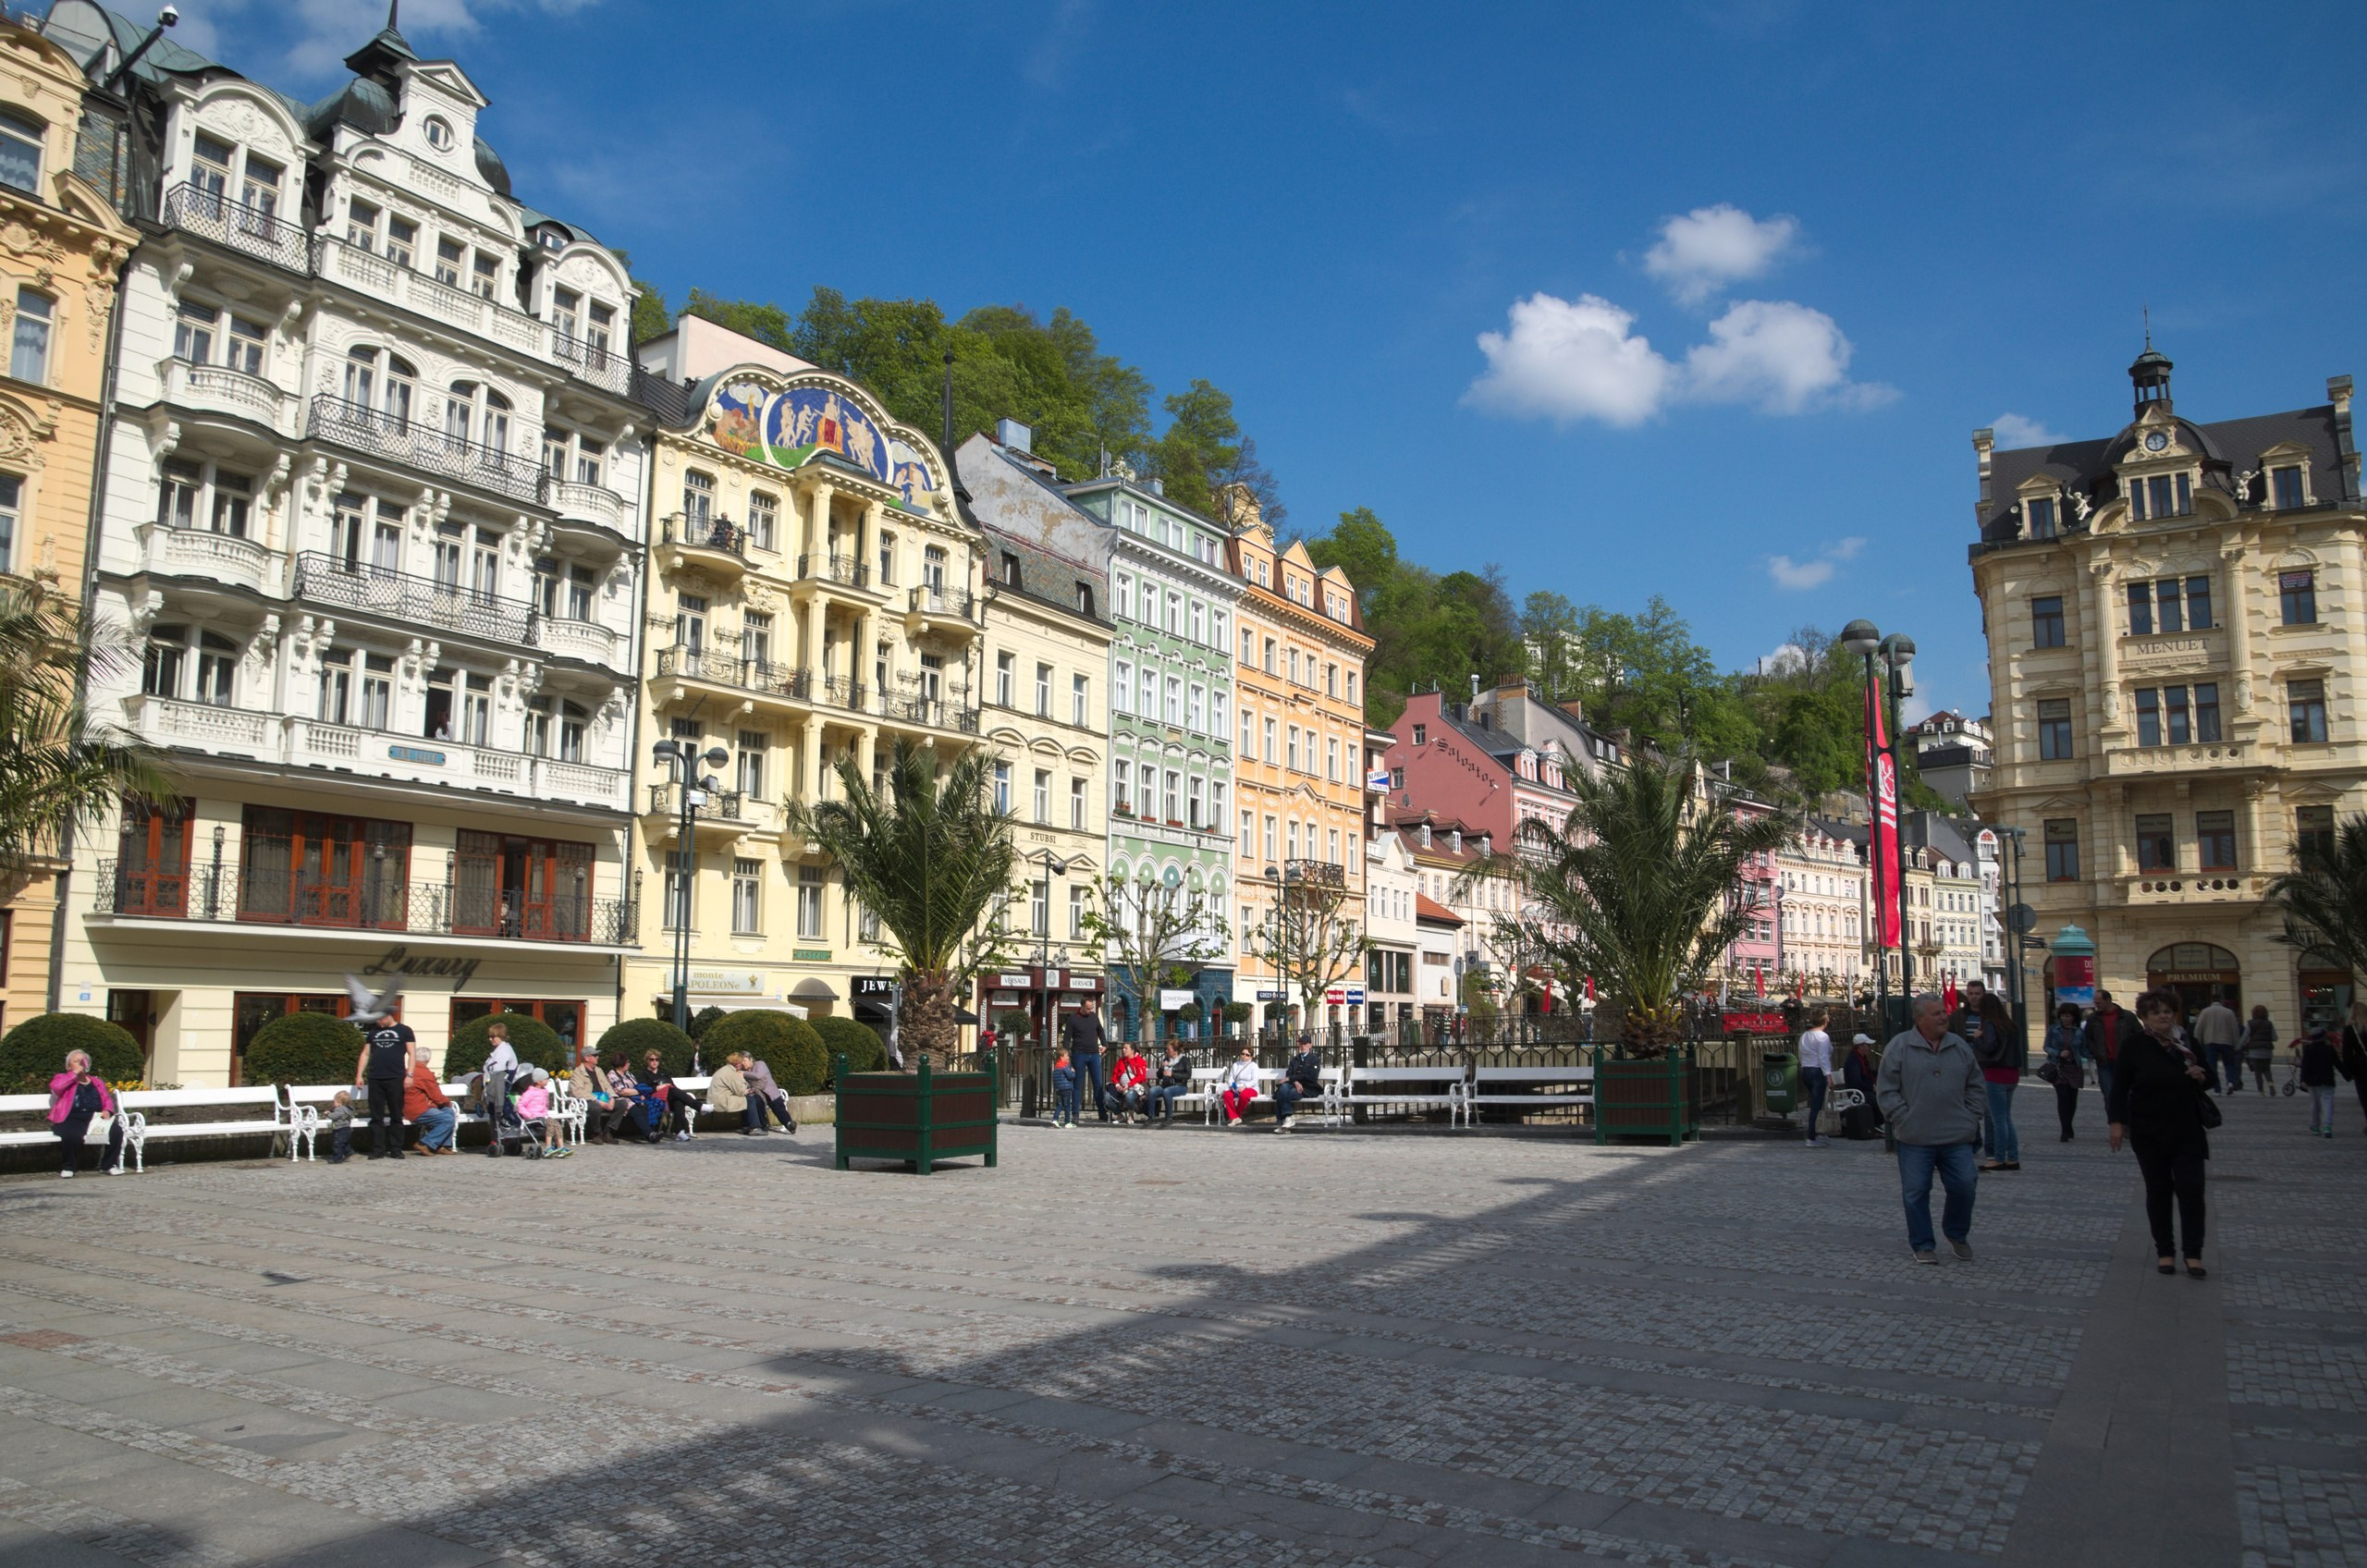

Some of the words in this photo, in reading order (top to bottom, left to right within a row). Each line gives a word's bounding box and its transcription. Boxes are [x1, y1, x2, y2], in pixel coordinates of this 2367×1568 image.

[2137, 638, 2210, 655] MENUET
[1434, 739, 1494, 787] Salvator
[1030, 832, 1056, 843] STUBSI
[363, 944, 481, 994] Luxury
[687, 981, 740, 989] POLEONe
[2166, 974, 2220, 982] PREMIUM
